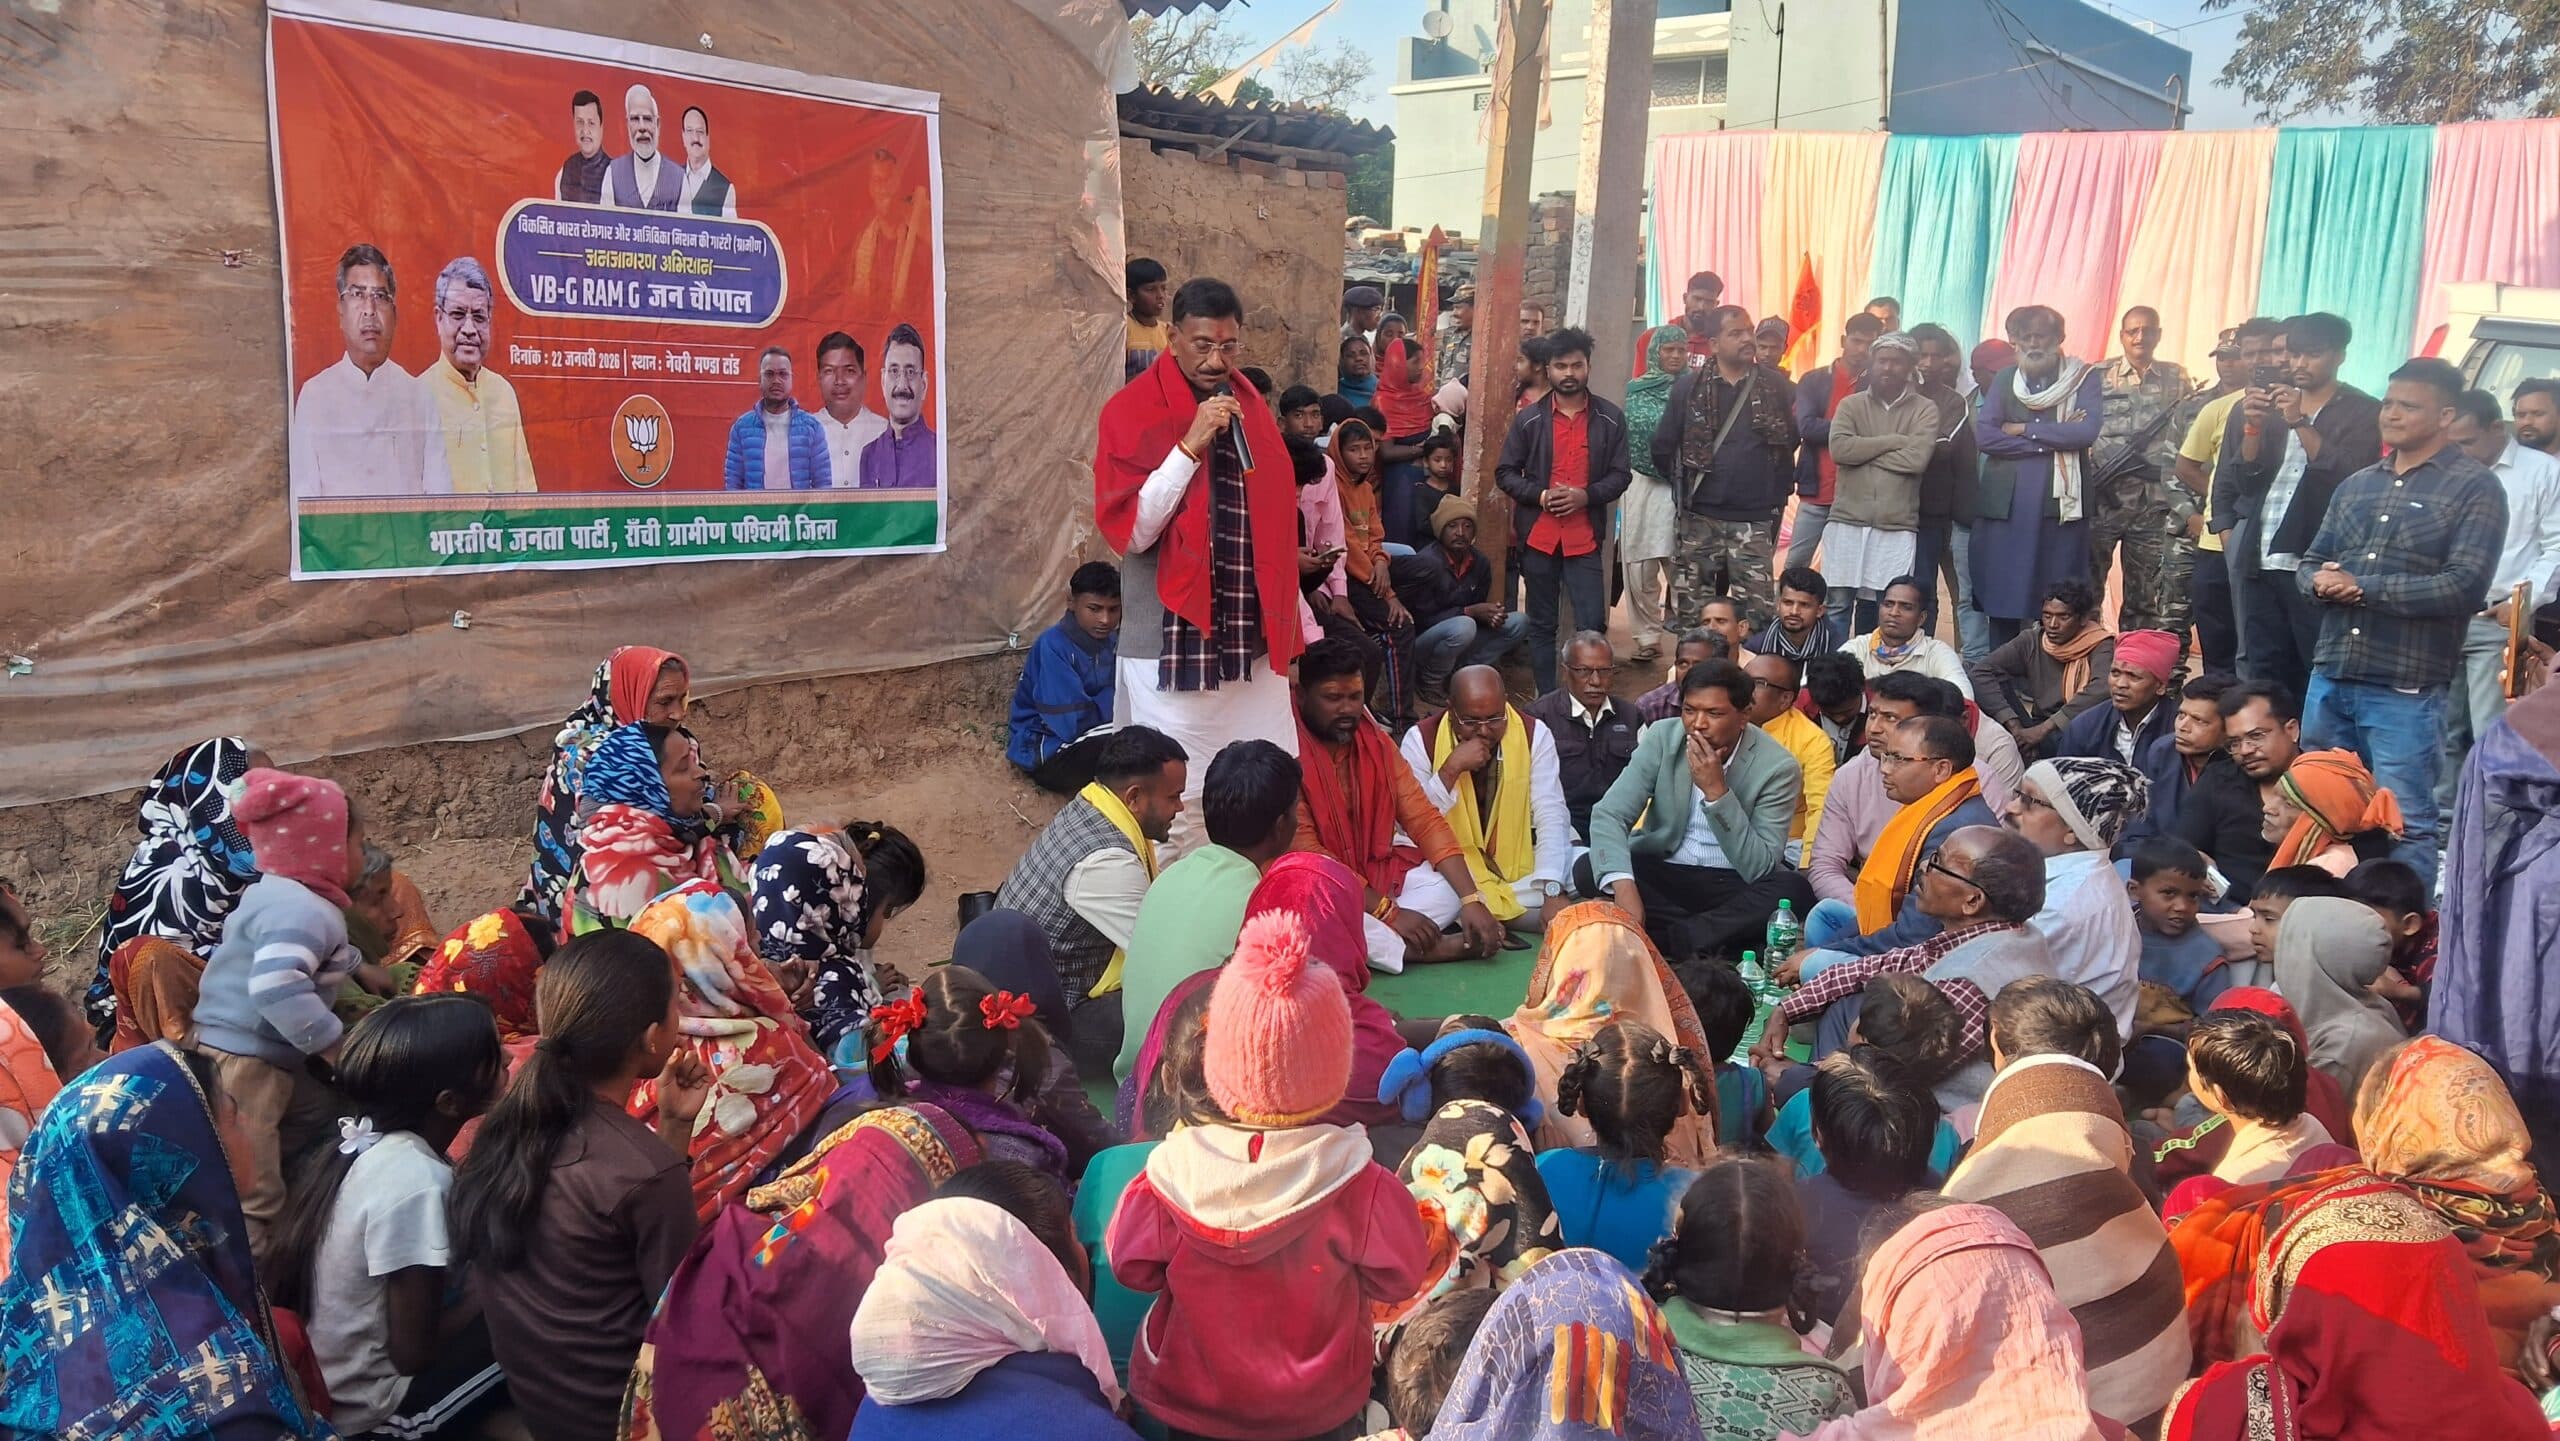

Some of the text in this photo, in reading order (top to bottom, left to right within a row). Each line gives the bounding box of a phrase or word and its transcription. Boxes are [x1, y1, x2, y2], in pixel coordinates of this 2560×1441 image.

[517, 214, 555, 235] विकसित
[557, 221, 580, 237] भारत
[581, 219, 613, 240] रोजगार
[615, 222, 630, 242] और
[672, 228, 697, 248] मिशन
[698, 231, 710, 249] की
[710, 232, 731, 250] गारंटी
[585, 248, 714, 276] जनजागरण अभियान
[530, 274, 752, 314] VB-G RAM G जन चौपाल
[509, 344, 542, 365] दिनांक
[551, 351, 563, 367] 22
[564, 347, 596, 367] जनवरी
[599, 352, 620, 369] 2026
[631, 354, 656, 370] स्थान
[694, 355, 720, 375] मण्डा
[429, 522, 503, 555] भारतीय
[508, 526, 566, 552] जनता
[569, 517, 618, 553] पार्टी,
[666, 516, 727, 547] ग्रामीण
[731, 514, 791, 544] पश्चिमी
[795, 513, 838, 541] जिला
